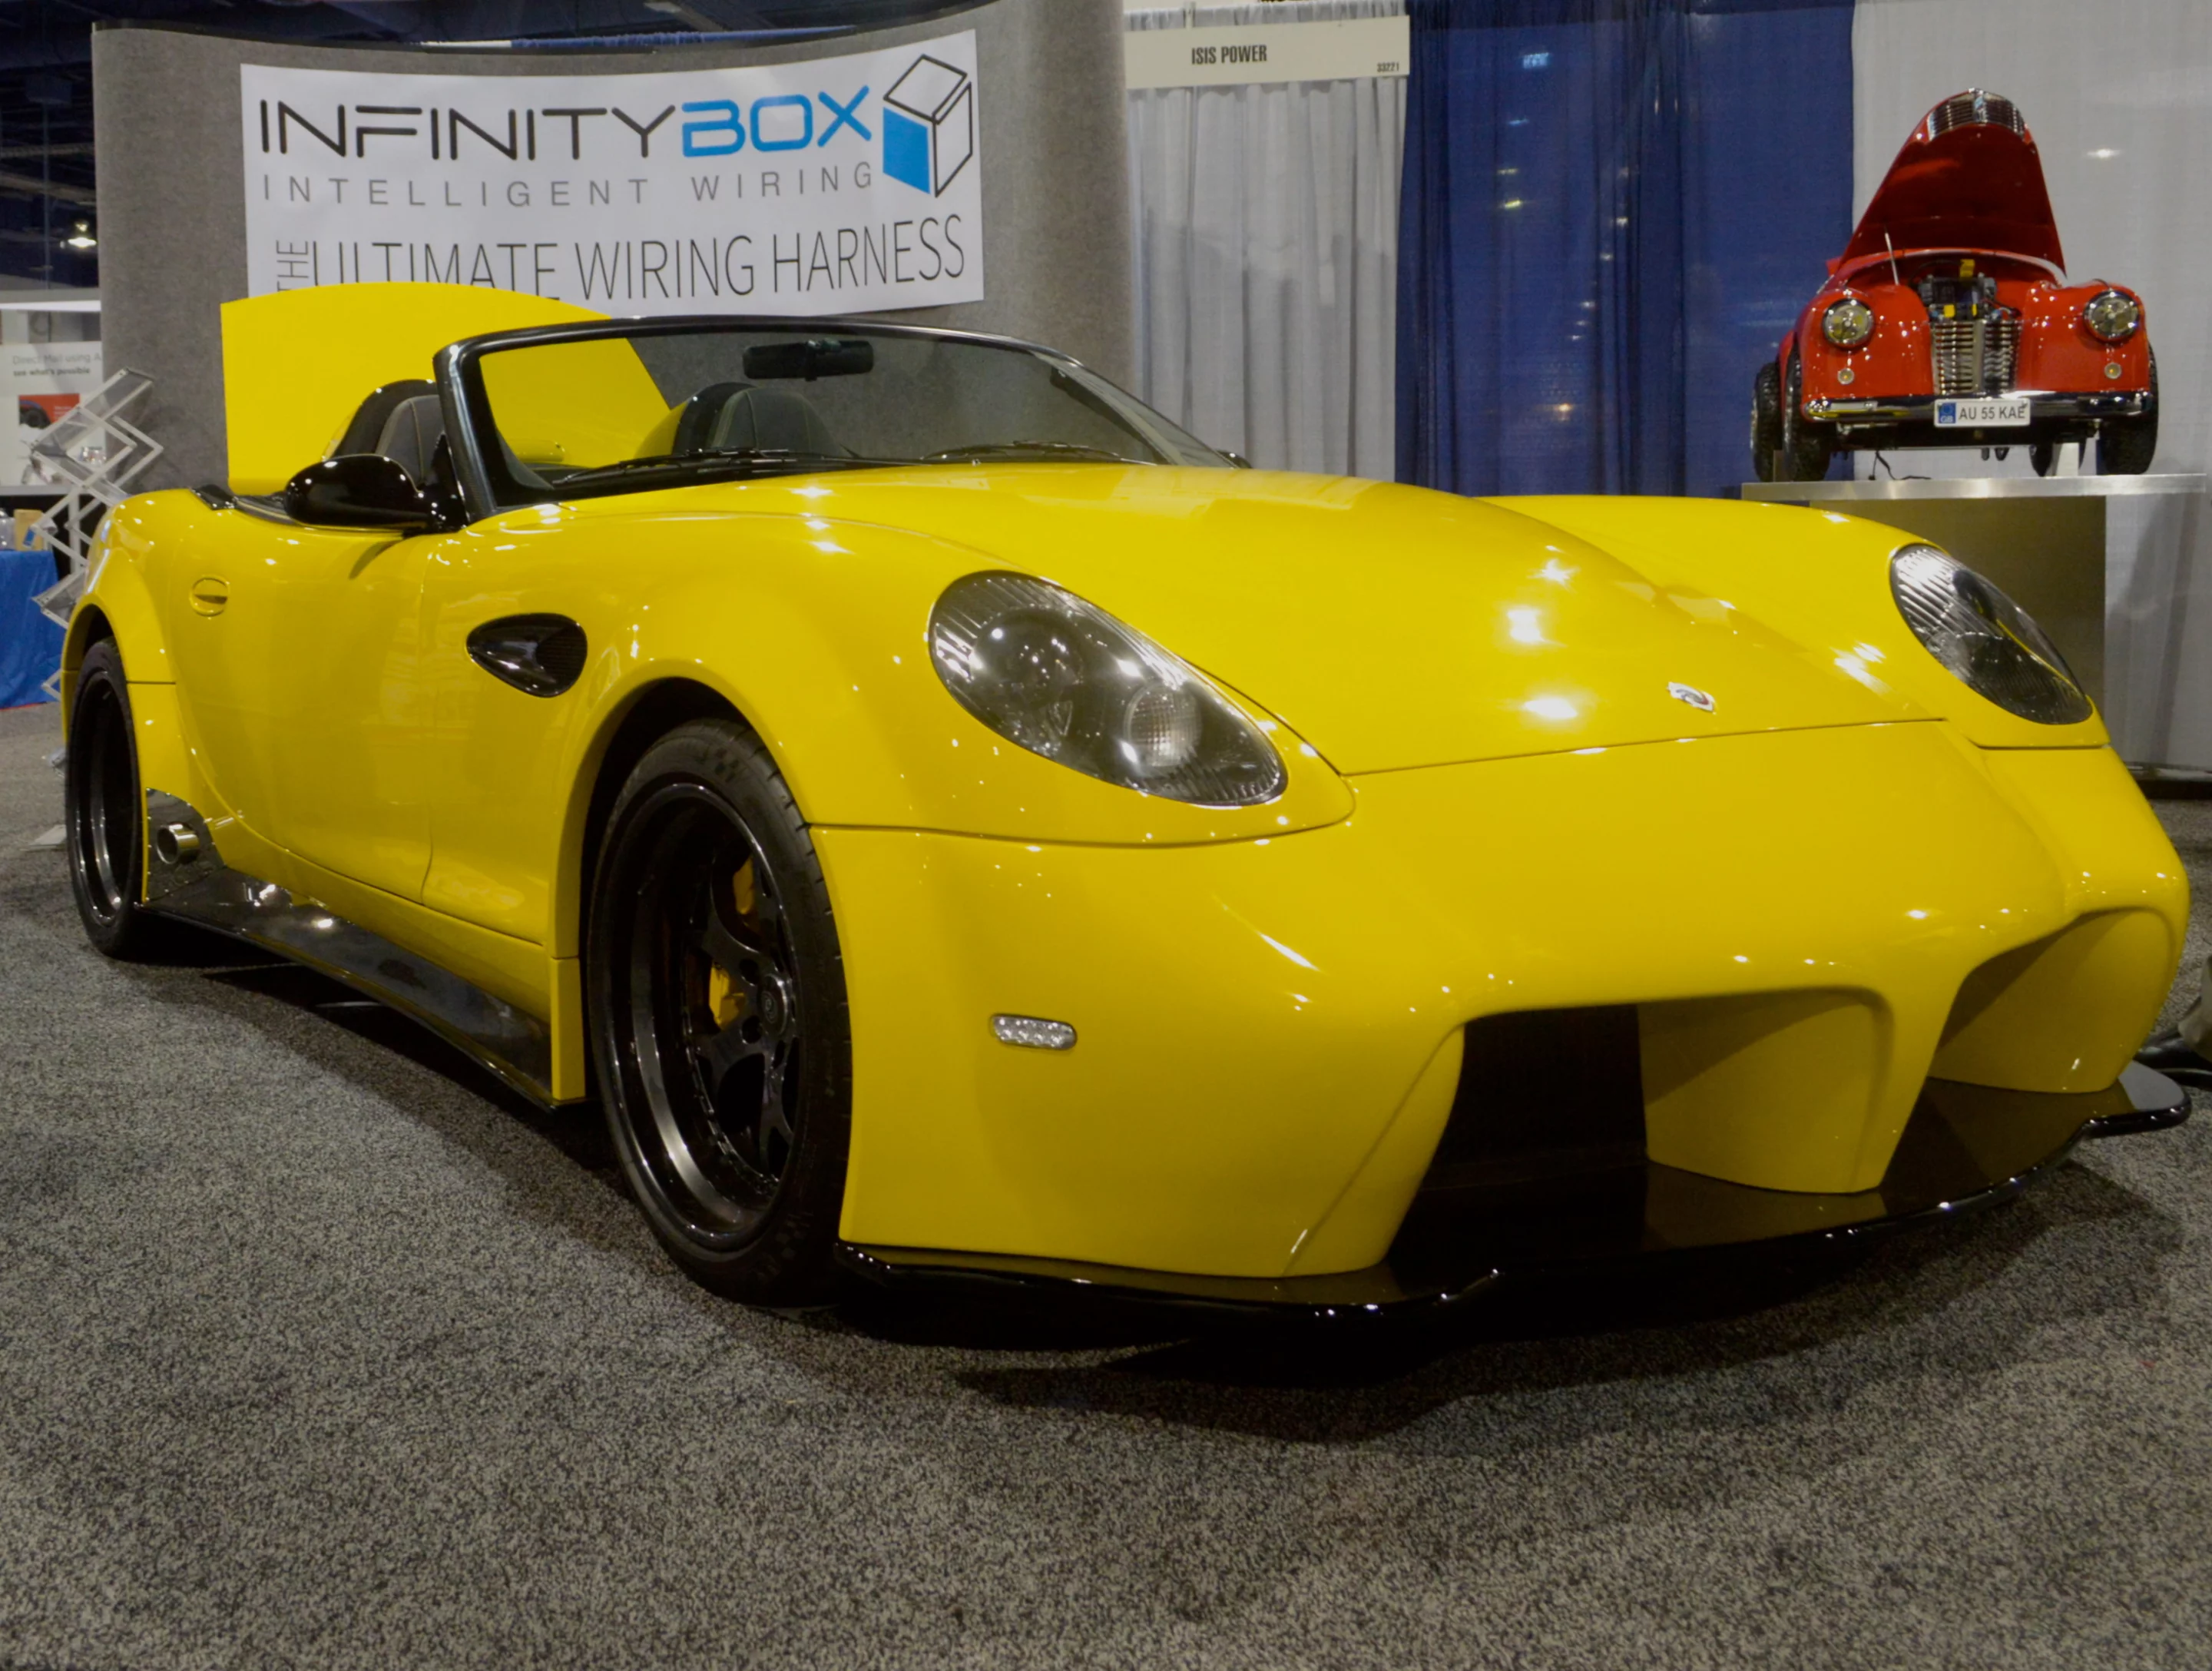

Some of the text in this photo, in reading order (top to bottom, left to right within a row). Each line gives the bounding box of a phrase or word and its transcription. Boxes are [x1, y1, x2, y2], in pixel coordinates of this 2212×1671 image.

[1191, 45, 1267, 65] ISIS POWER
[260, 85, 872, 161] INFINITYBOX
[263, 161, 872, 207] INTELLIGENT WIRING
[575, 234, 754, 300] WIRING
[773, 214, 965, 293] HARNESS
[1959, 408, 1977, 420] AU
[1981, 407, 1995, 419] 55
